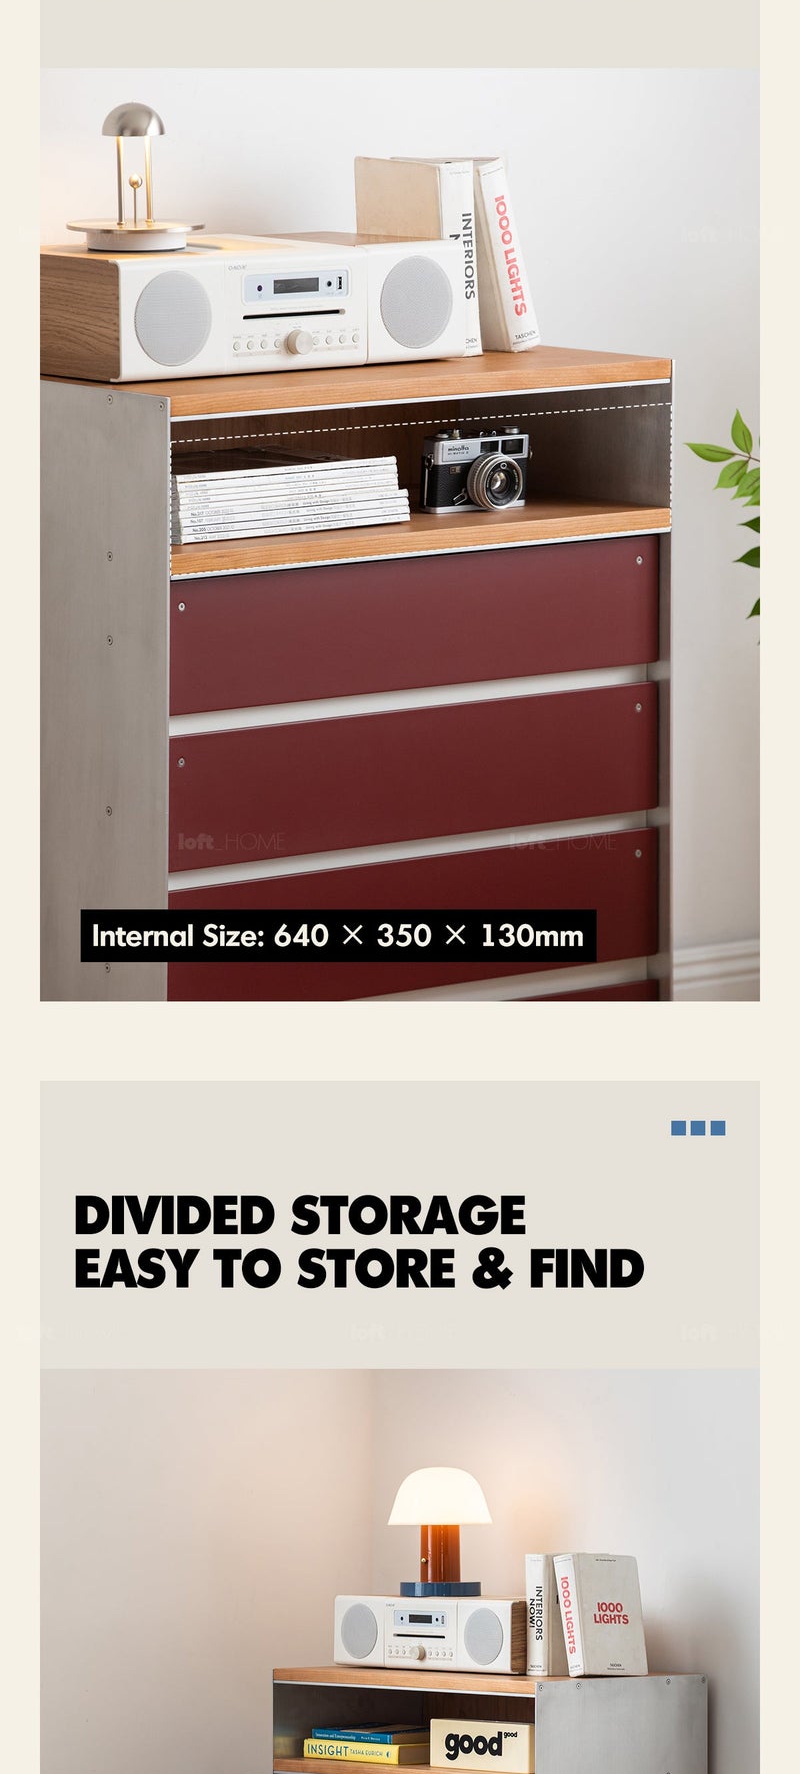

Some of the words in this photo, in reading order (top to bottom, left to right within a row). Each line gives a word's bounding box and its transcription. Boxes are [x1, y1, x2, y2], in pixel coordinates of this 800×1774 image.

[462, 213, 475, 300] INTERIORS
[494, 194, 512, 245] 1000
[504, 247, 527, 317] LIGHTS
[560, 1576, 572, 1608] 1000
[593, 1614, 629, 1624] LIGHTS
[597, 1602, 623, 1613] 1000
[564, 1610, 576, 1655] LIGHTS
[307, 1744, 349, 1756] INSIGHT
[445, 1731, 502, 1760] good
